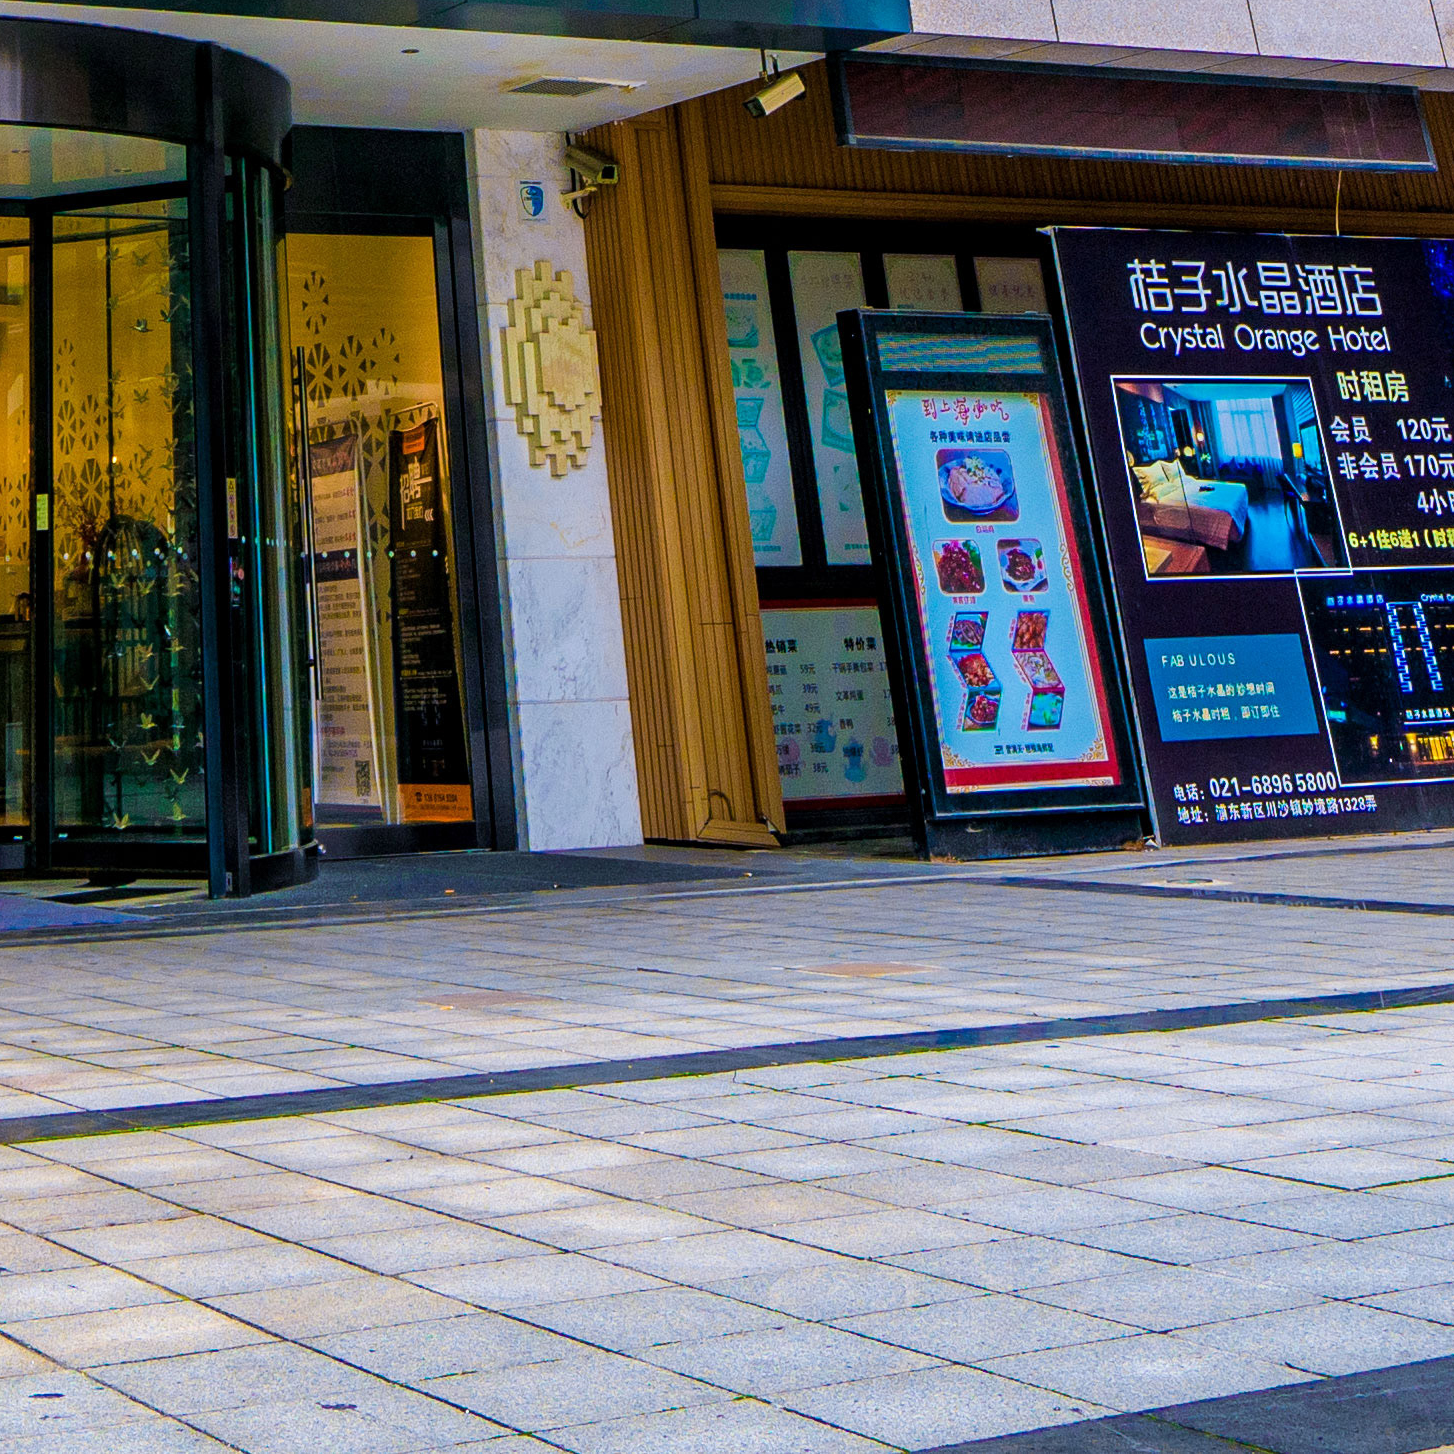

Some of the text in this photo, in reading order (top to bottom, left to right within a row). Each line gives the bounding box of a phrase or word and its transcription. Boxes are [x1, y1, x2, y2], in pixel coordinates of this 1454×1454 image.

[1127, 258, 1383, 317] 桔子水晶酒店
[1139, 322, 1391, 357] Crystal Orange Hotel
[1336, 371, 1410, 403] 时租房
[1330, 415, 1453, 443] 会员 120元
[1338, 452, 1402, 481] 非会员
[1296, 770, 1338, 793] 5800
